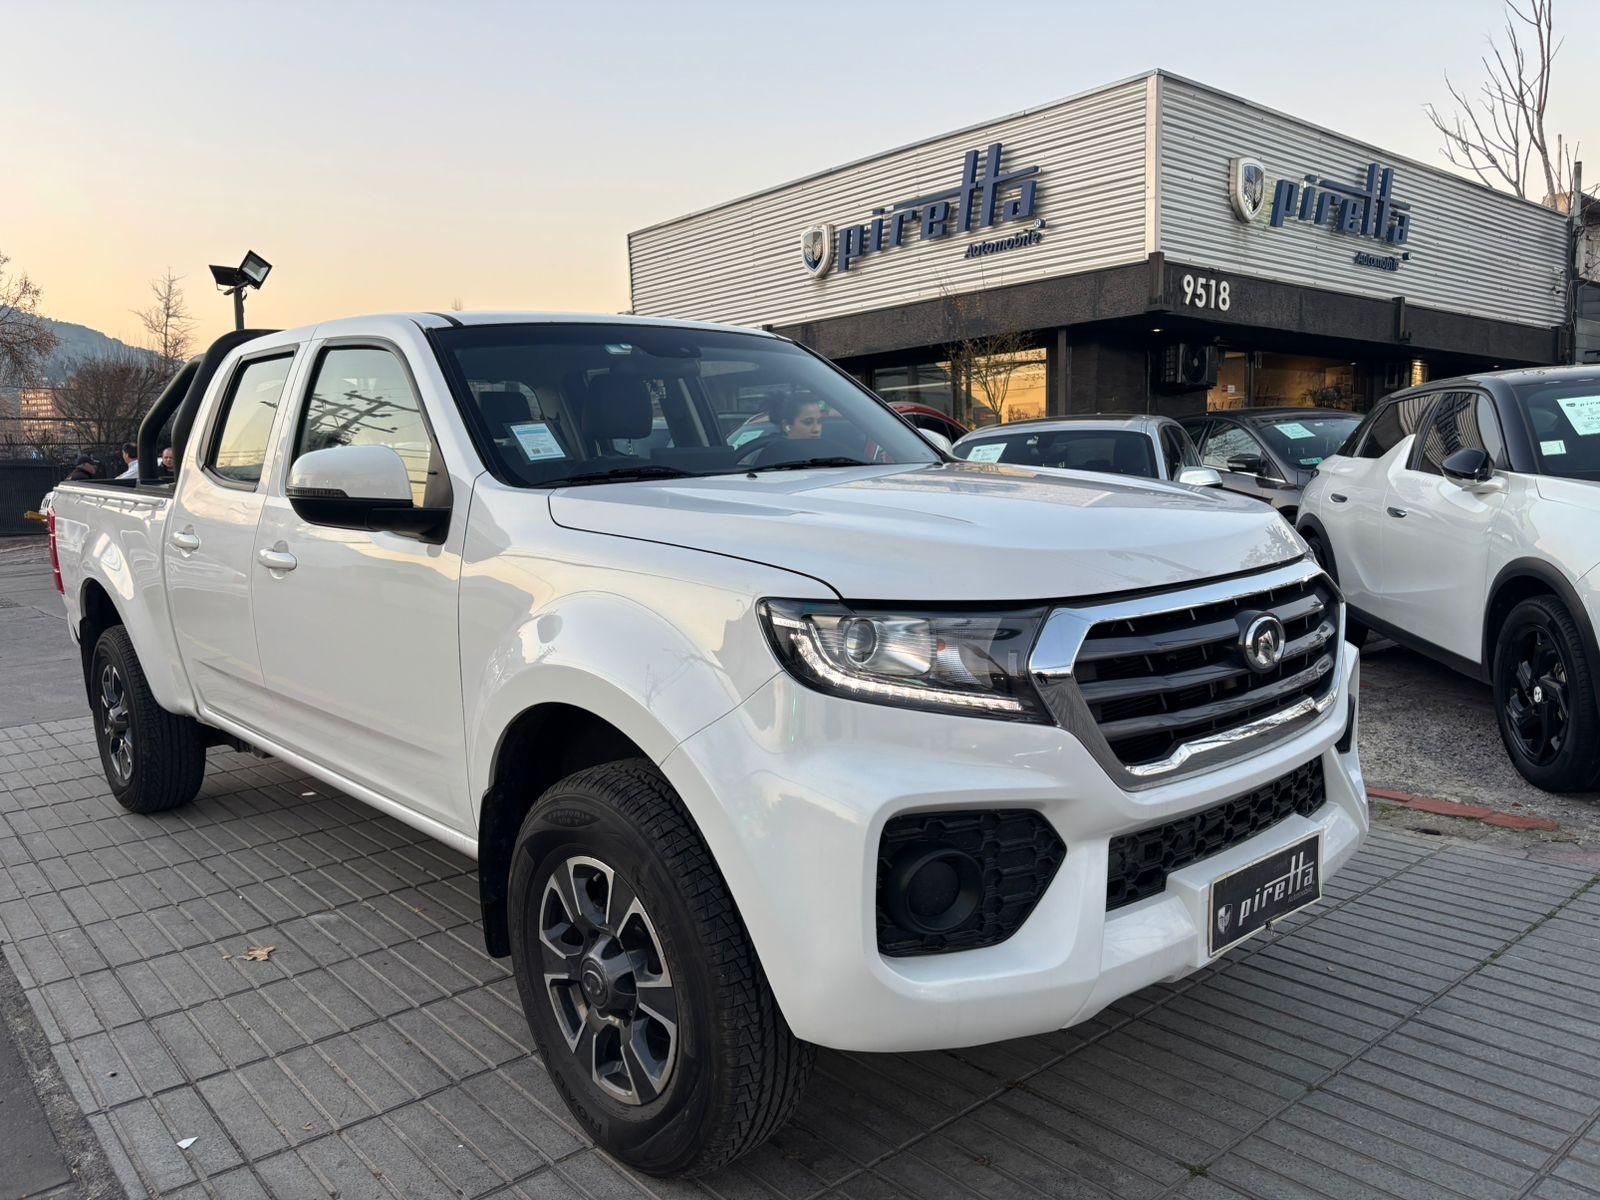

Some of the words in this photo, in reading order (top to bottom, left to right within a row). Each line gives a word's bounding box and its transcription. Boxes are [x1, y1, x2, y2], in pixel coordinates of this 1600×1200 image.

[837, 142, 1041, 272] piretta
[1269, 163, 1411, 245] piretta
[964, 229, 1042, 258] Automobile
[1182, 274, 1231, 311] 9518
[1238, 851, 1315, 927] piretta
